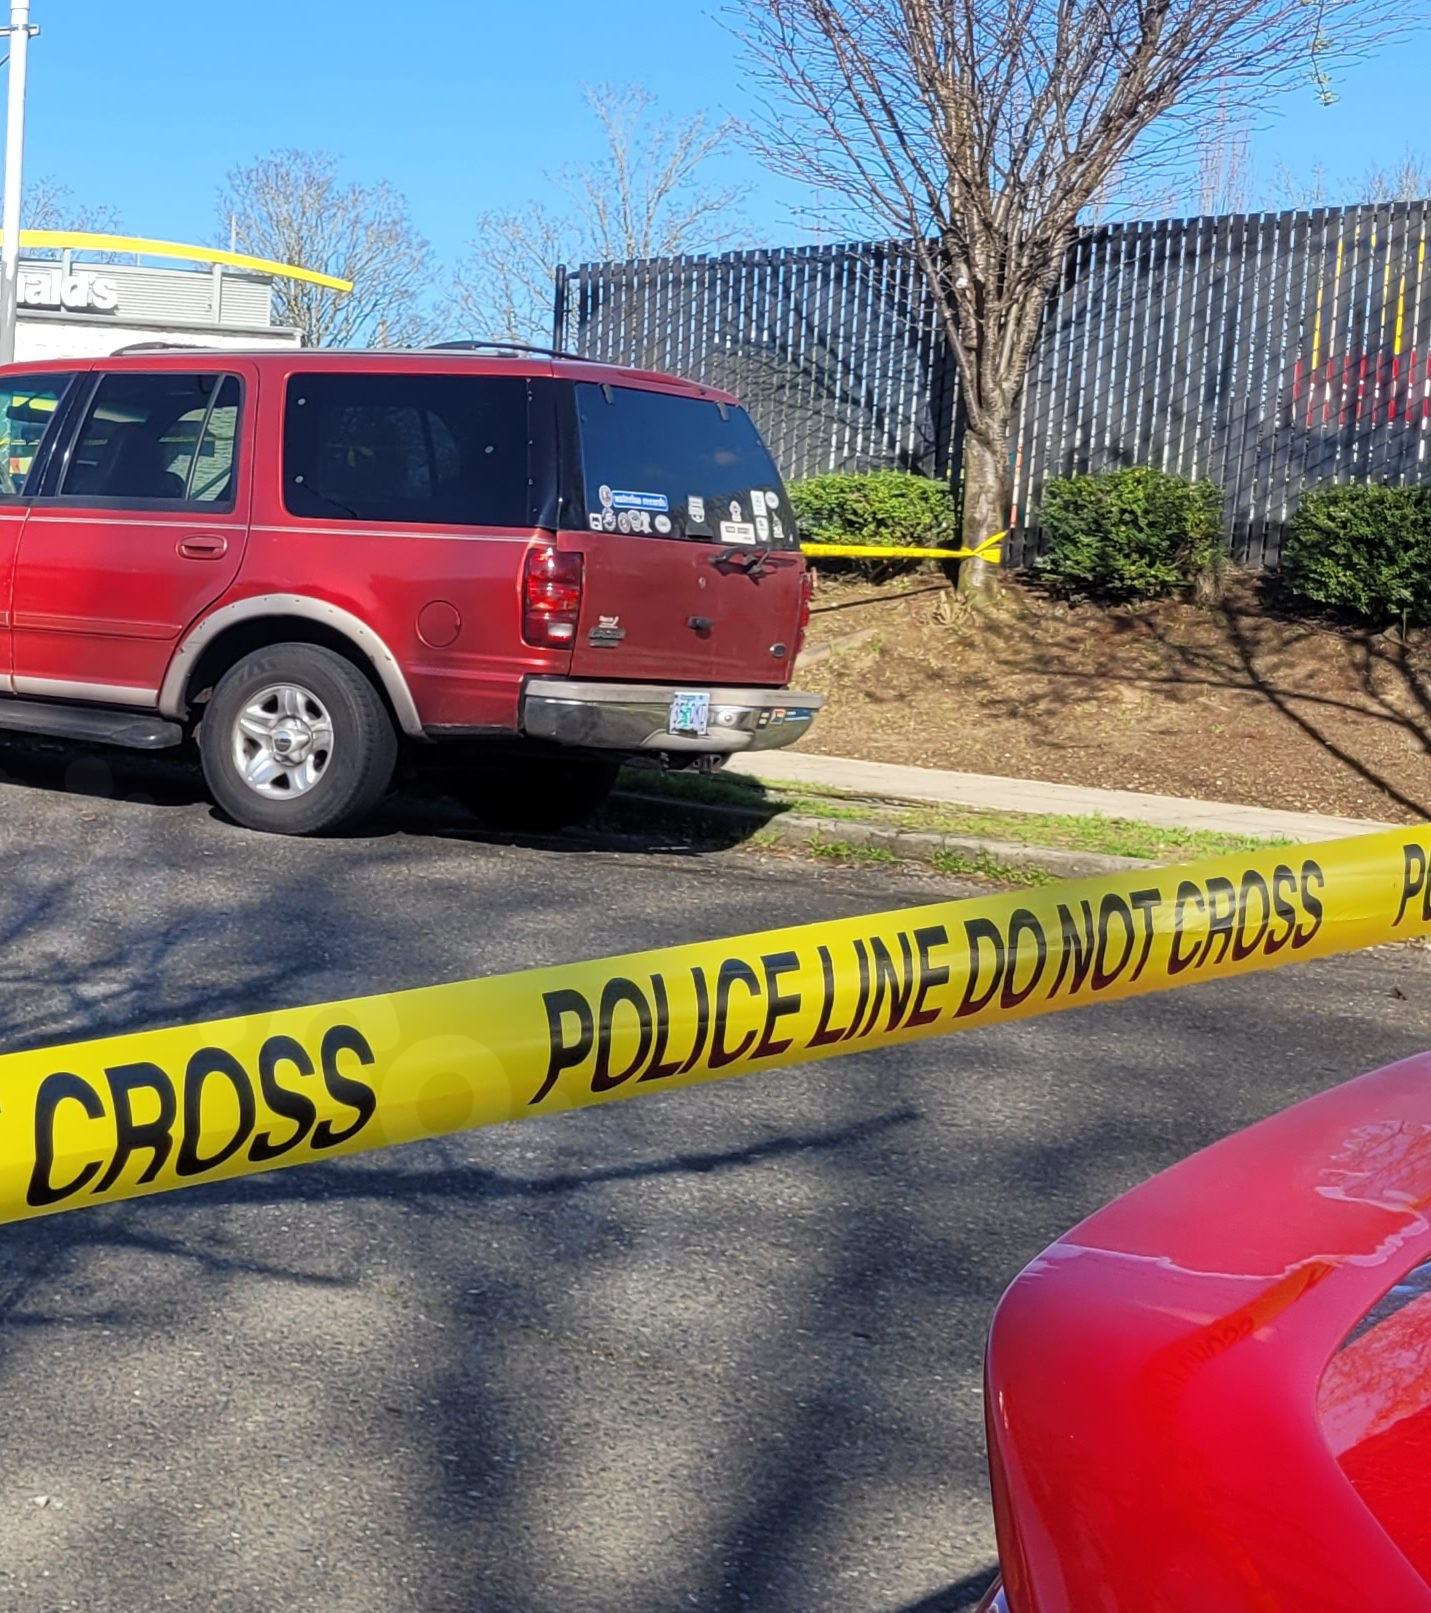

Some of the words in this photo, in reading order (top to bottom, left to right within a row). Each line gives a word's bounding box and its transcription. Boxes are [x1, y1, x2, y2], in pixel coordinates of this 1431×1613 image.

[528, 951, 802, 1105] POLICE
[805, 925, 951, 1048] LINE
[953, 908, 1047, 1018] DO
[1046, 888, 1162, 999] NOT
[1167, 859, 1325, 976] CROSS
[25, 1025, 377, 1207] CROSS
